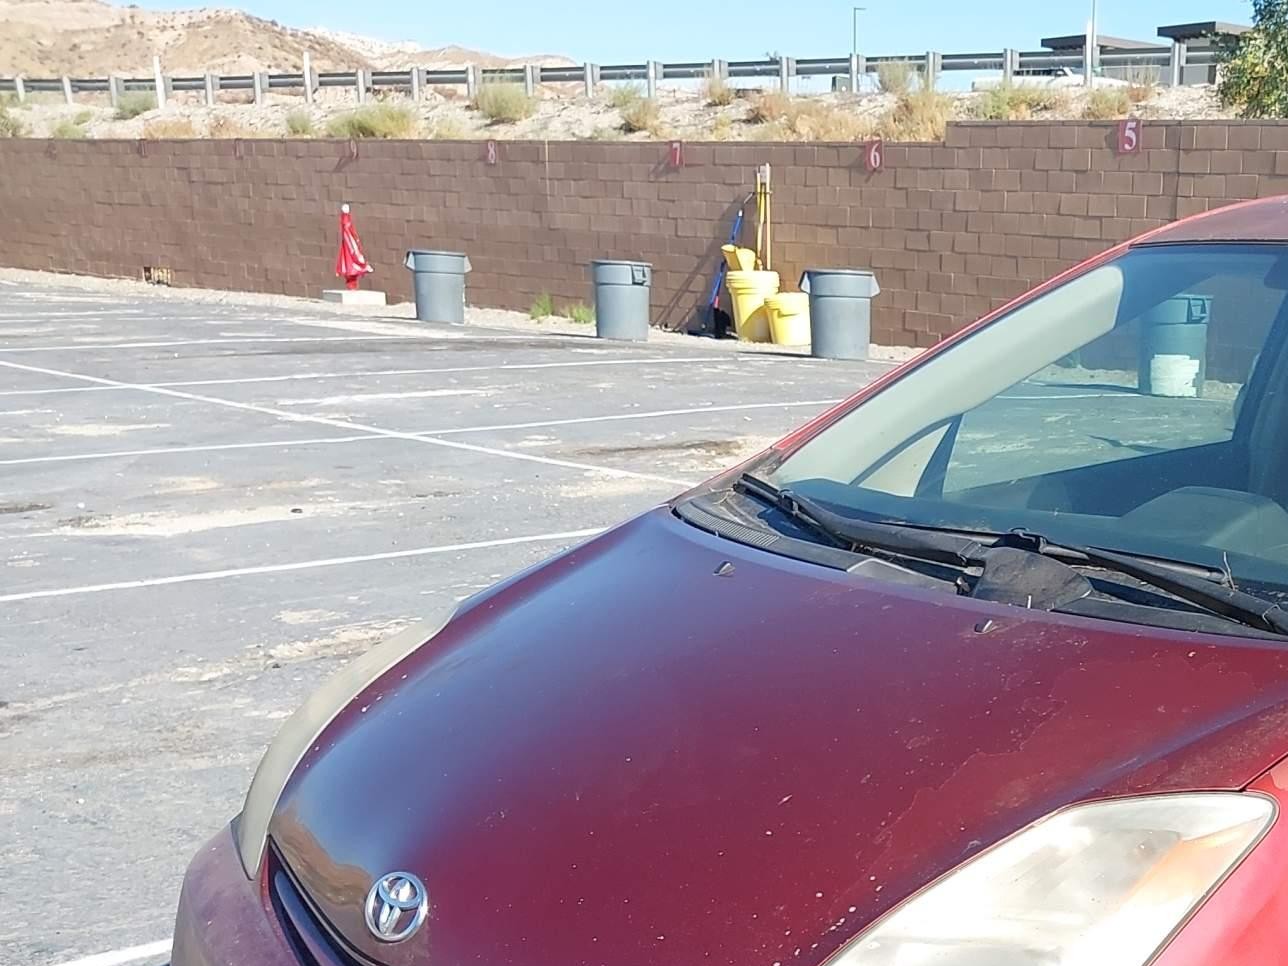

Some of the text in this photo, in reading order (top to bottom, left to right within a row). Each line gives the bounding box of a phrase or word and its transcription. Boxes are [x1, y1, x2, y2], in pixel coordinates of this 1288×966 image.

[1124, 121, 1137, 150] 5
[487, 140, 496, 164] 8
[672, 142, 681, 165] 7
[870, 143, 880, 169] 6
